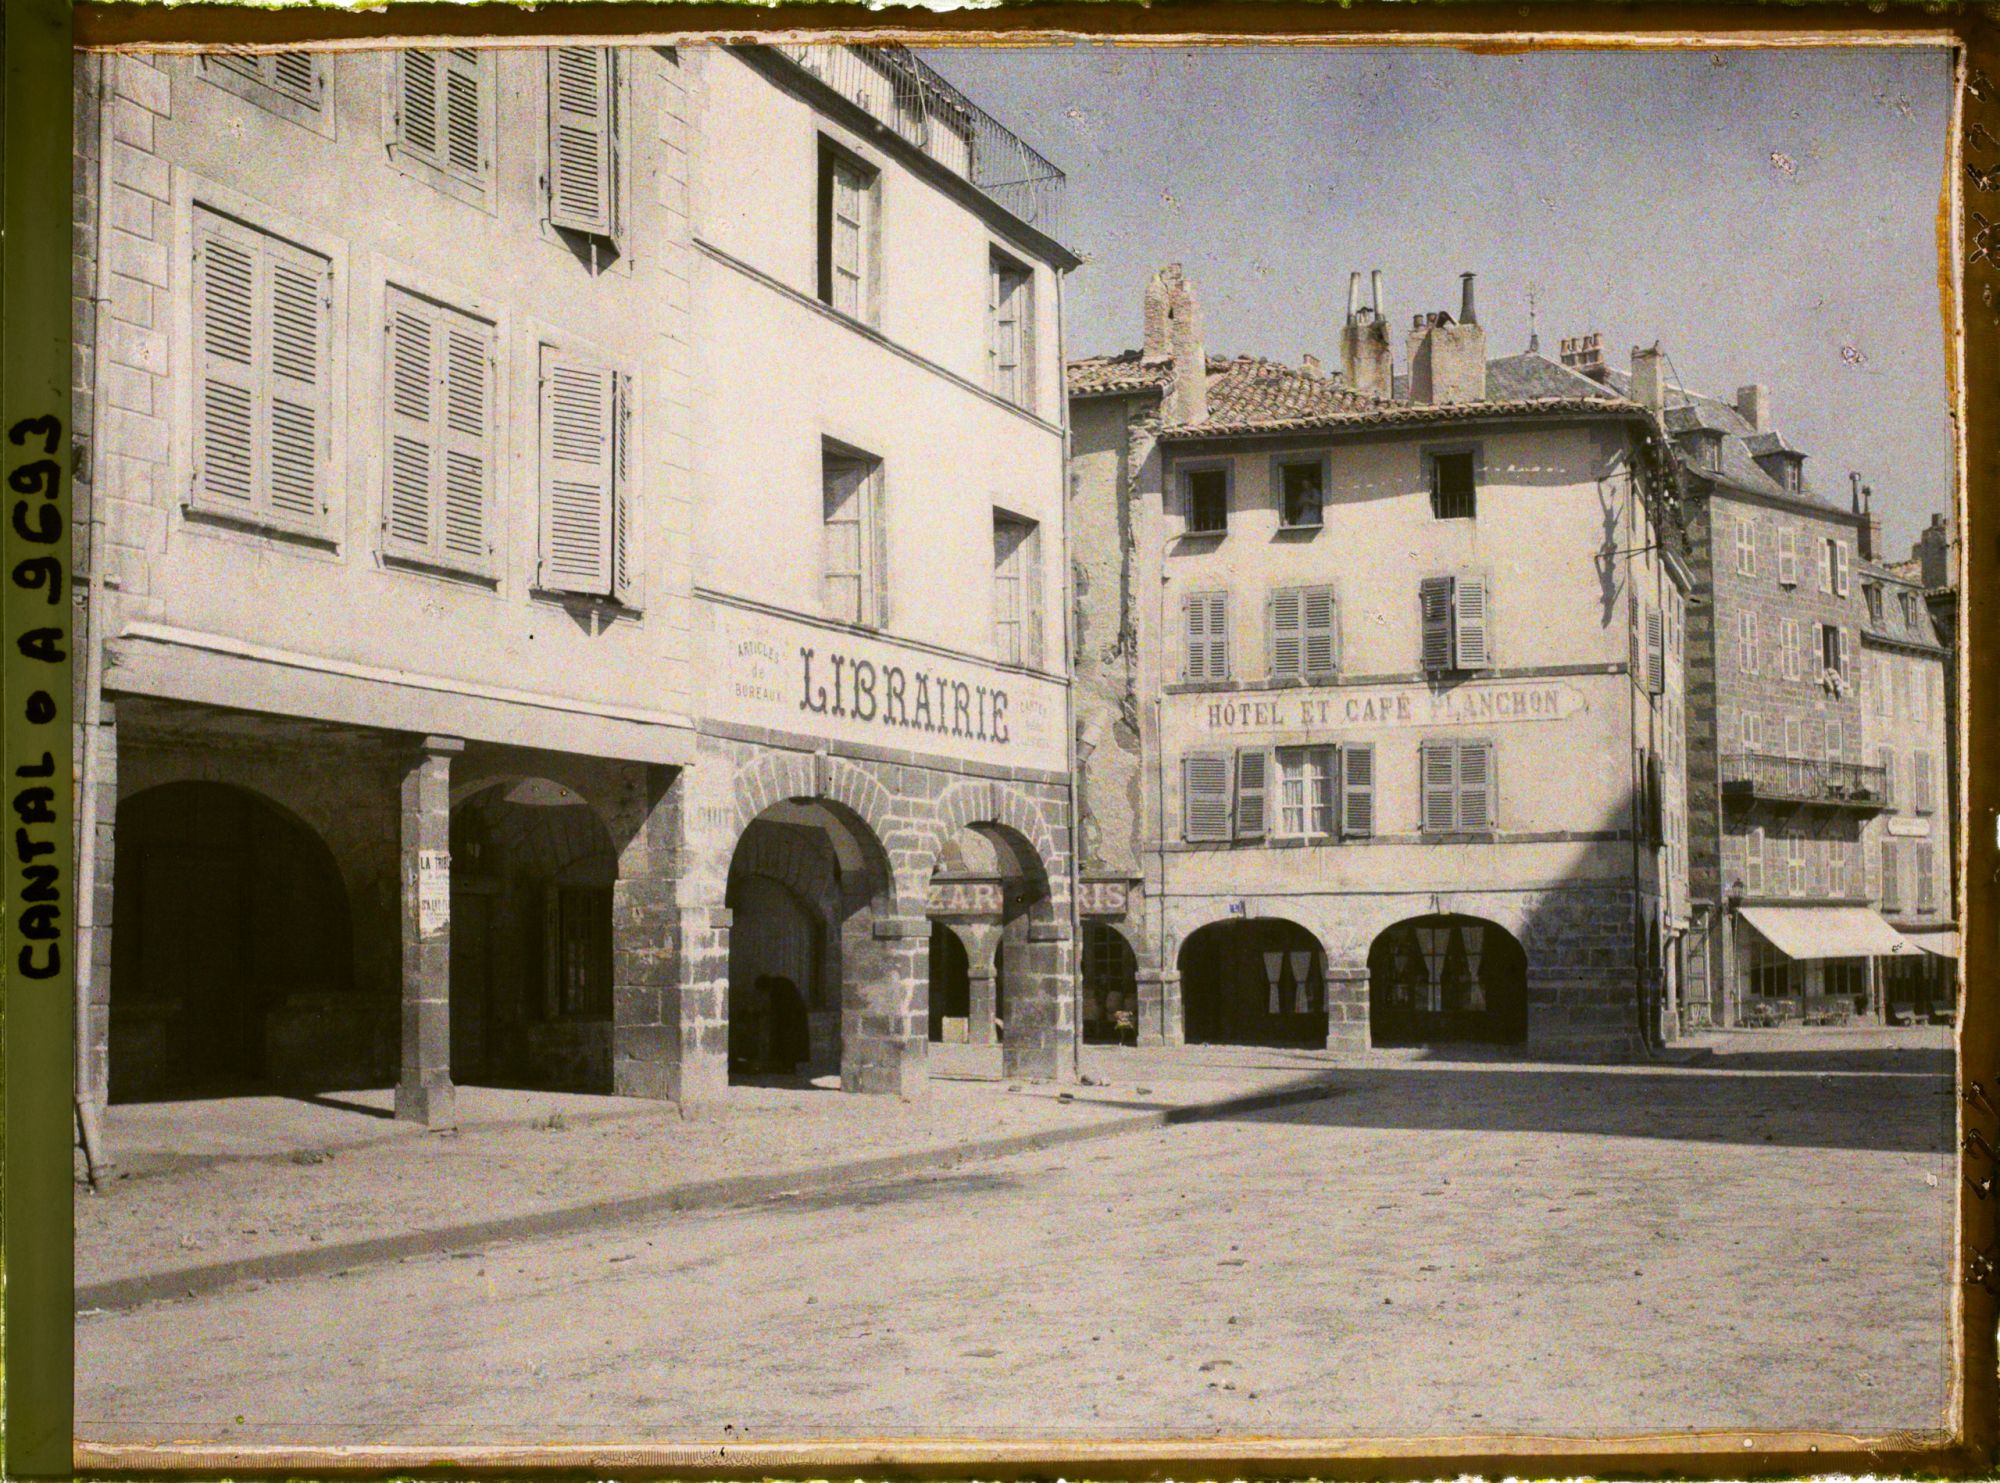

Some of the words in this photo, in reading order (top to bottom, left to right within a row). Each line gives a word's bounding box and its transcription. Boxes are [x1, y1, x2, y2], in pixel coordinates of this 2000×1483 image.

[8, 413, 62, 605] 9693
[17, 627, 66, 663] A
[800, 646, 1010, 744] LIBRAIRIE
[1207, 698, 1284, 727] HÔTEL
[1301, 699, 1330, 724] ET
[1345, 692, 1411, 723] CAFÉ
[13, 751, 62, 980] CANTAL
